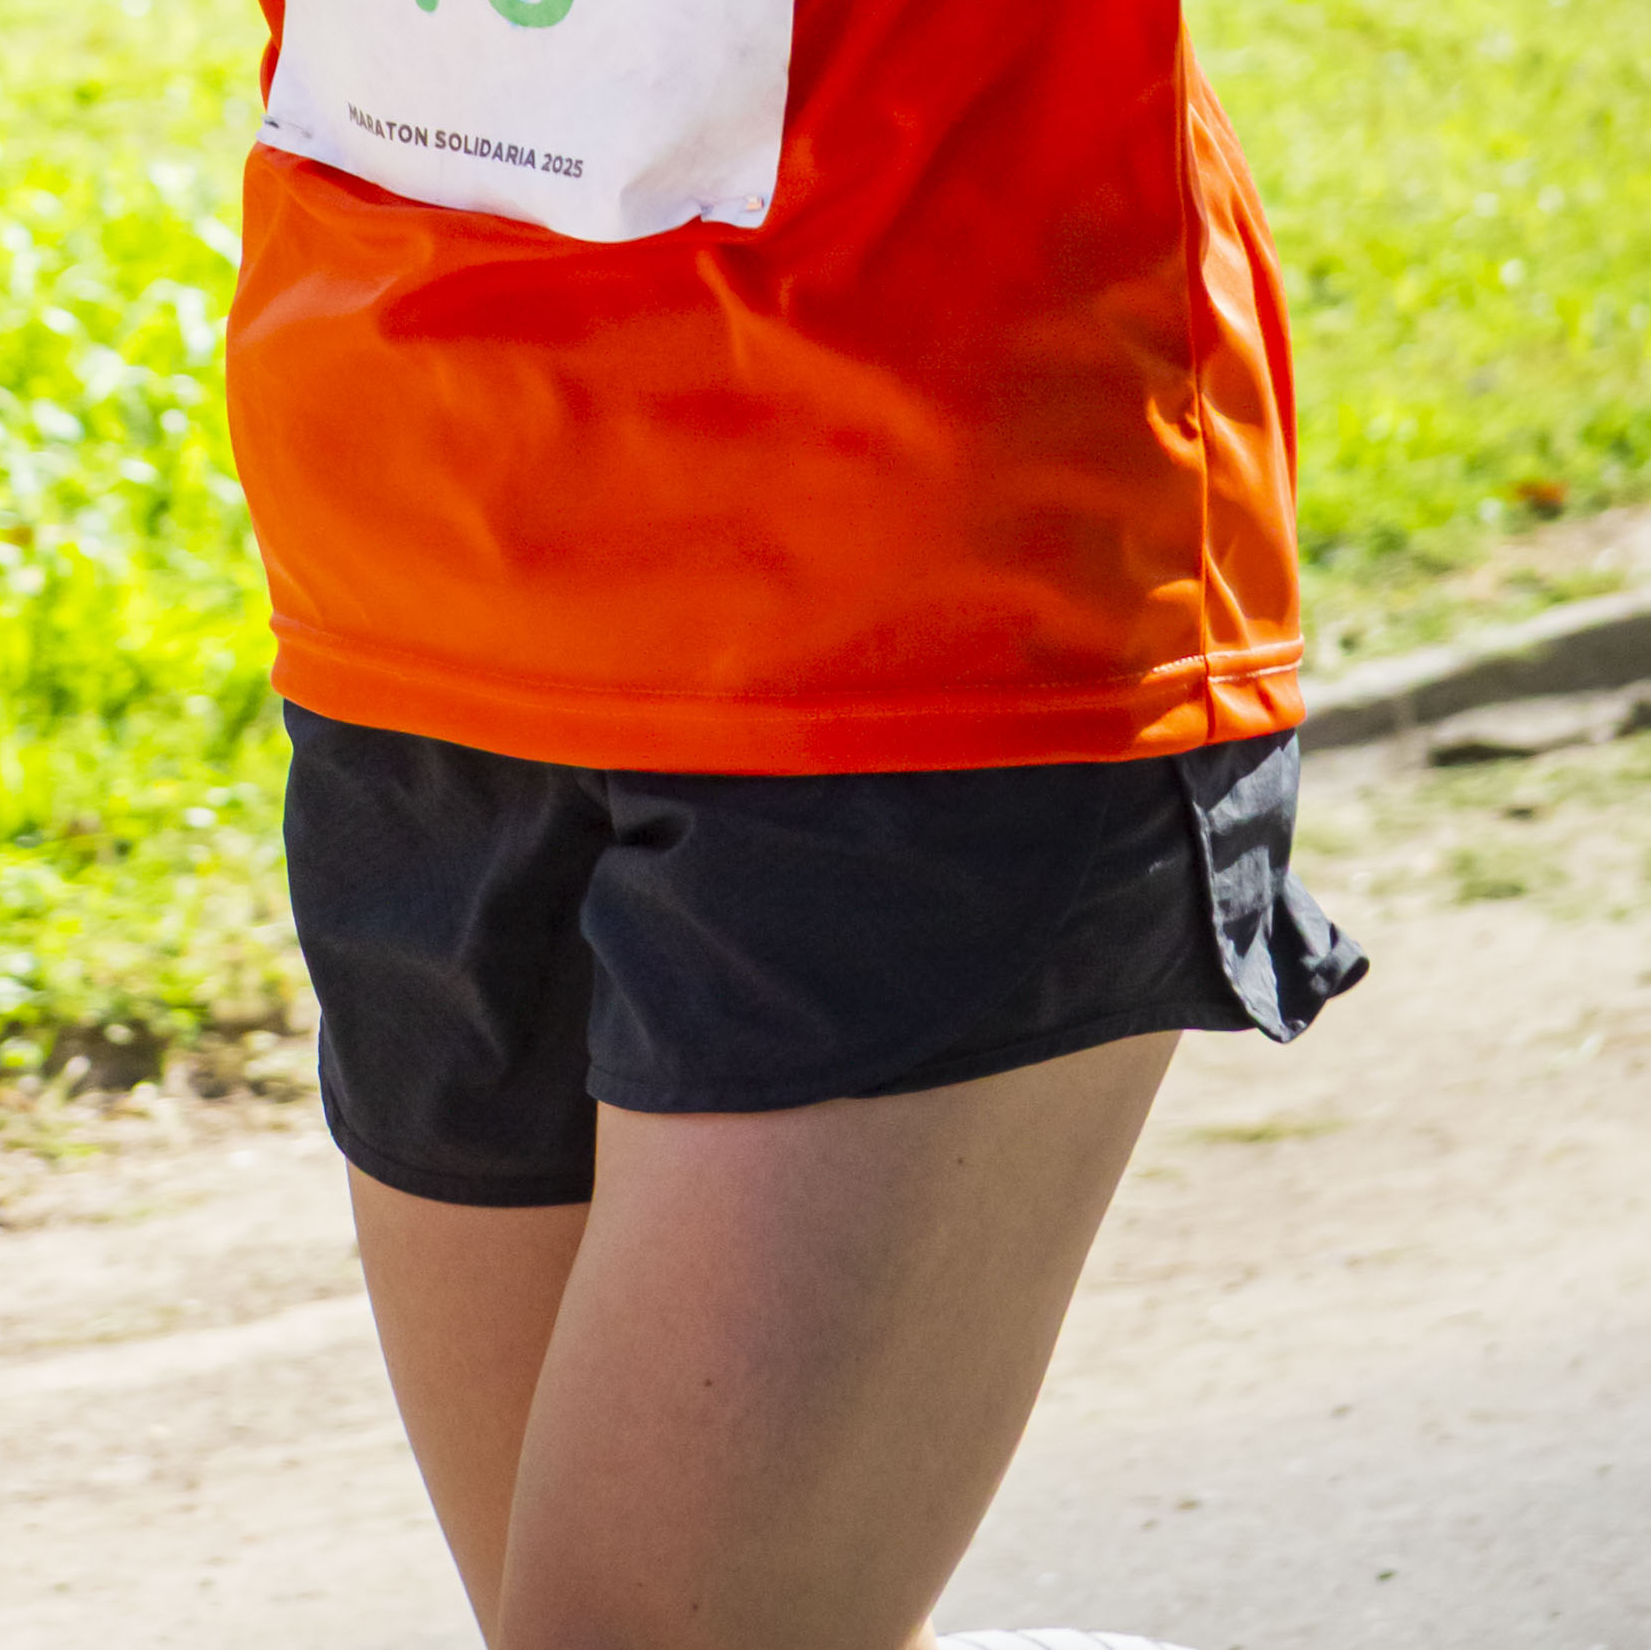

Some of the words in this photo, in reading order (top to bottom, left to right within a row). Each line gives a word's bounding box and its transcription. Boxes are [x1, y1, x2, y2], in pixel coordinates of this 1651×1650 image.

[348, 103, 429, 147] MARATON
[434, 129, 536, 169] SOLIDARIA
[541, 153, 584, 178] 2025
